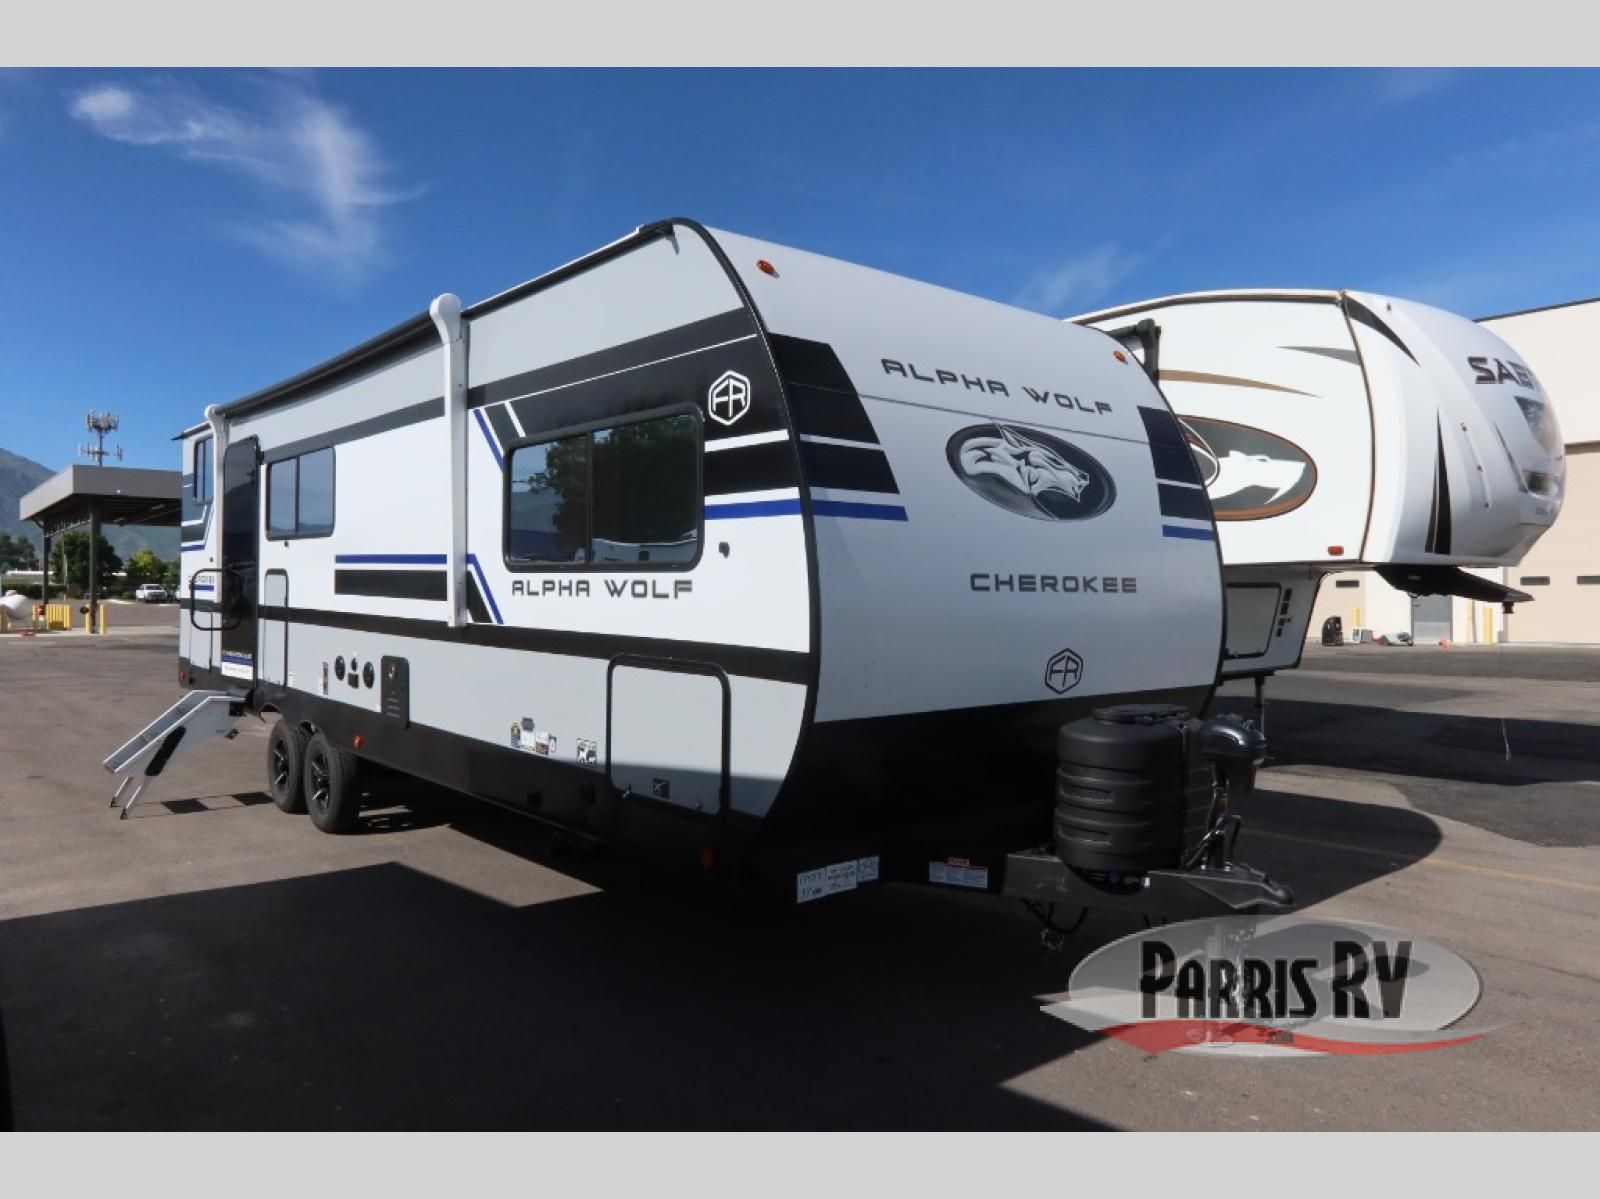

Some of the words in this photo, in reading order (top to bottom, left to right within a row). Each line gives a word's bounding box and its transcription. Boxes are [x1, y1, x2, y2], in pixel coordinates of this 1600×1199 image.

[880, 358, 1010, 397] ALPHA
[1022, 386, 1114, 415] WOLF
[512, 579, 590, 597] ALPHA
[604, 579, 693, 600] WOLF
[969, 573, 1138, 594] CHEROKEE
